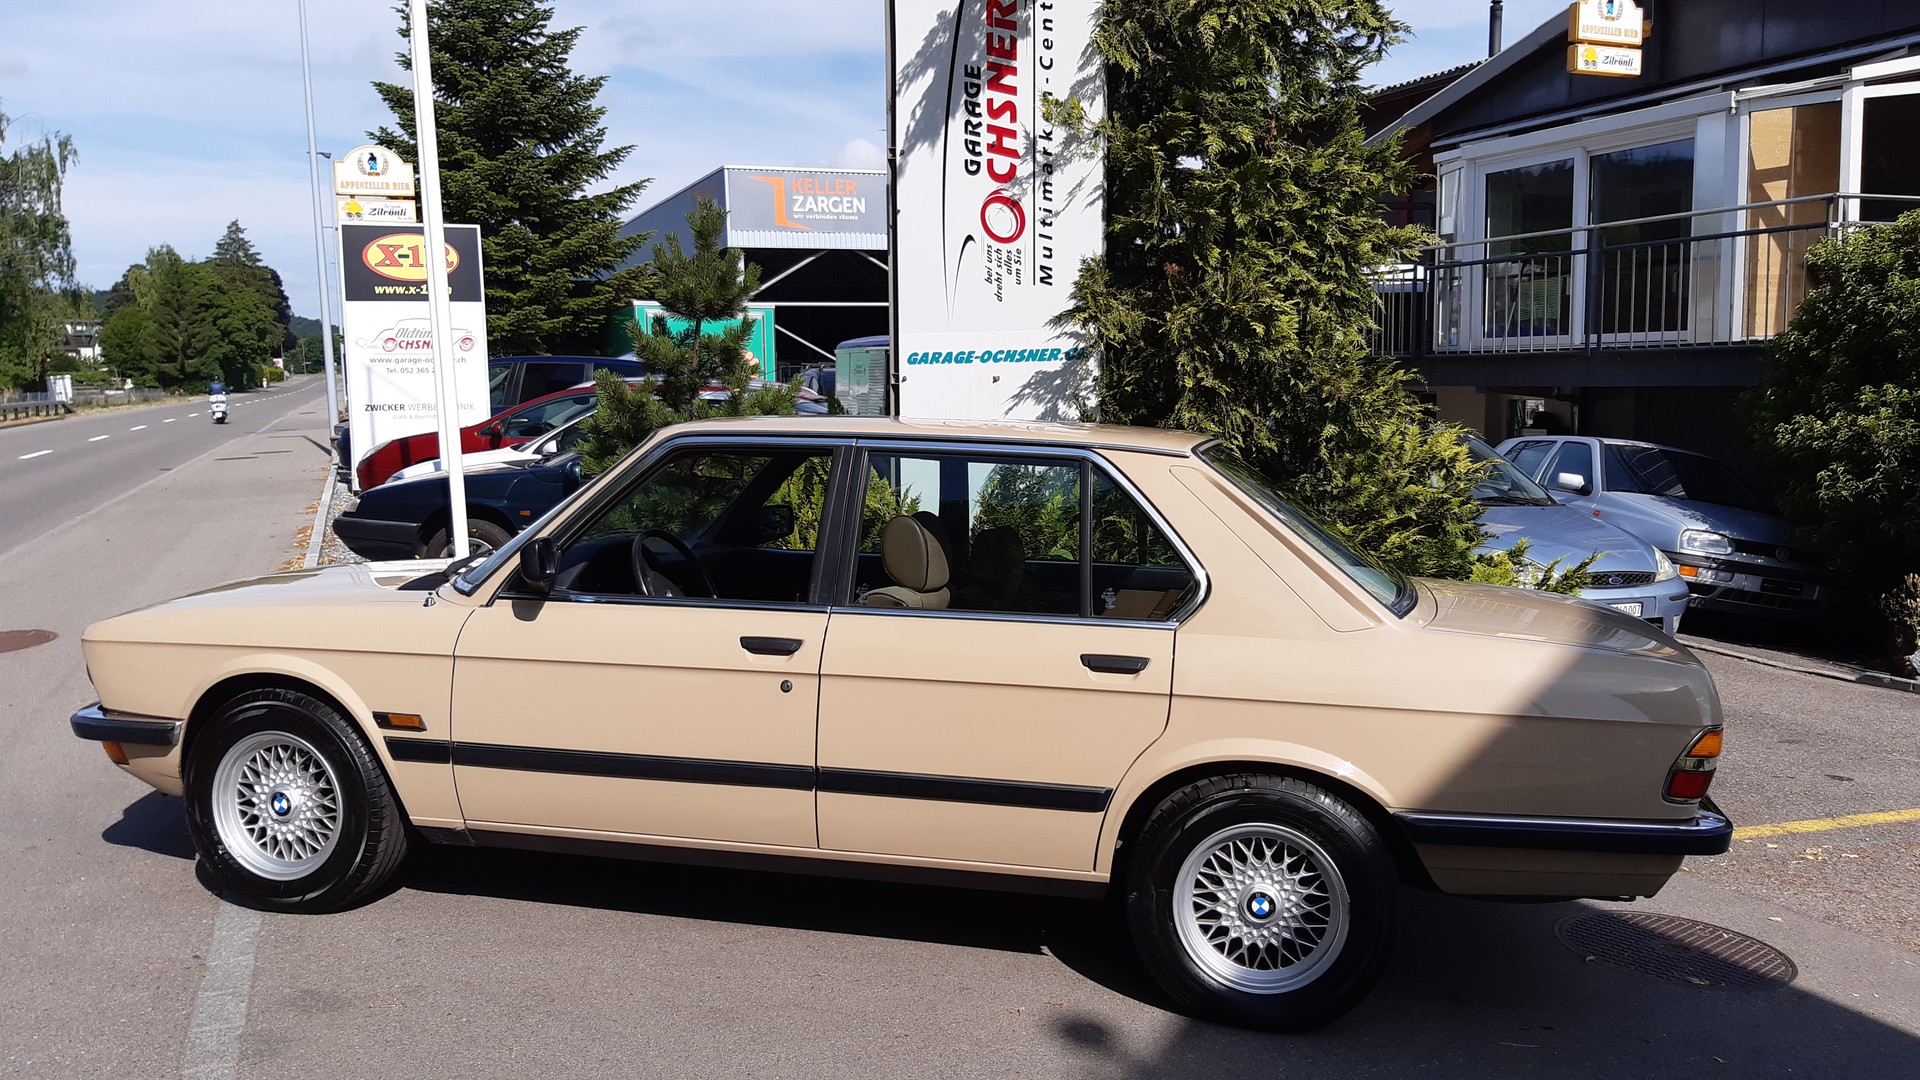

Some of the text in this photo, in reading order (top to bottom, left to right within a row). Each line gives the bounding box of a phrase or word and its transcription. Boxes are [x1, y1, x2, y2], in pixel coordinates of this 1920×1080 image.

[1582, 24, 1638, 38] APPENZELLER BIER
[964, 64, 982, 176] GARAGE
[340, 181, 410, 191] APPENZELLER BIER
[791, 177, 857, 195] KELLER
[792, 195, 866, 213] ZARGEN
[1003, 249, 1013, 275] alles
[1013, 248, 1022, 286] um Sie
[984, 265, 993, 285] bei
[994, 248, 1003, 302] dreht sich
[395, 327, 433, 338] Oldtim
[382, 337, 433, 352] OCHSN
[369, 356, 466, 364] www.garage-oc.ch
[364, 402, 475, 412] ZWICKER WERBENIK
